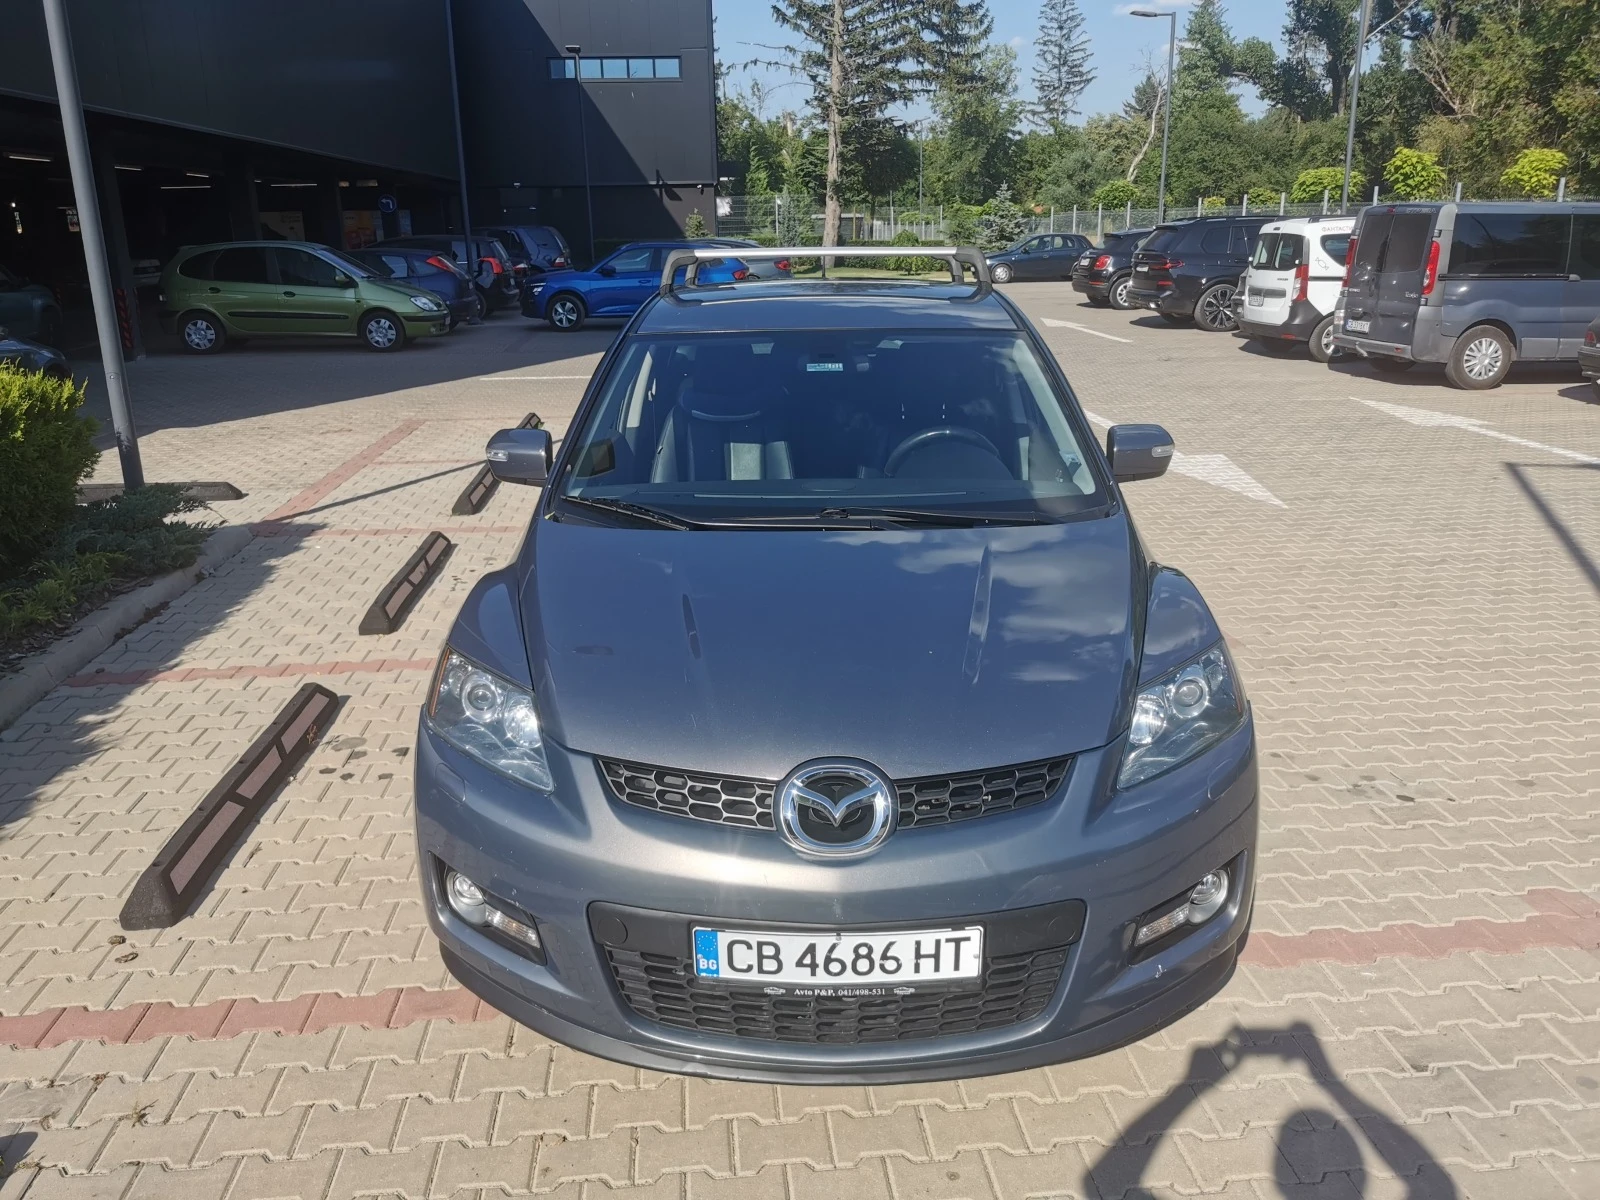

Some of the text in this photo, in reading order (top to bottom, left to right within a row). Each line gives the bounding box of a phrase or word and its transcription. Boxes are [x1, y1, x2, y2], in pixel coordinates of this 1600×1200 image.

[726, 936, 971, 977] CB 4686 HT
[699, 958, 717, 971] BG
[794, 988, 813, 996] Avto
[837, 988, 886, 996] 041/498-531
